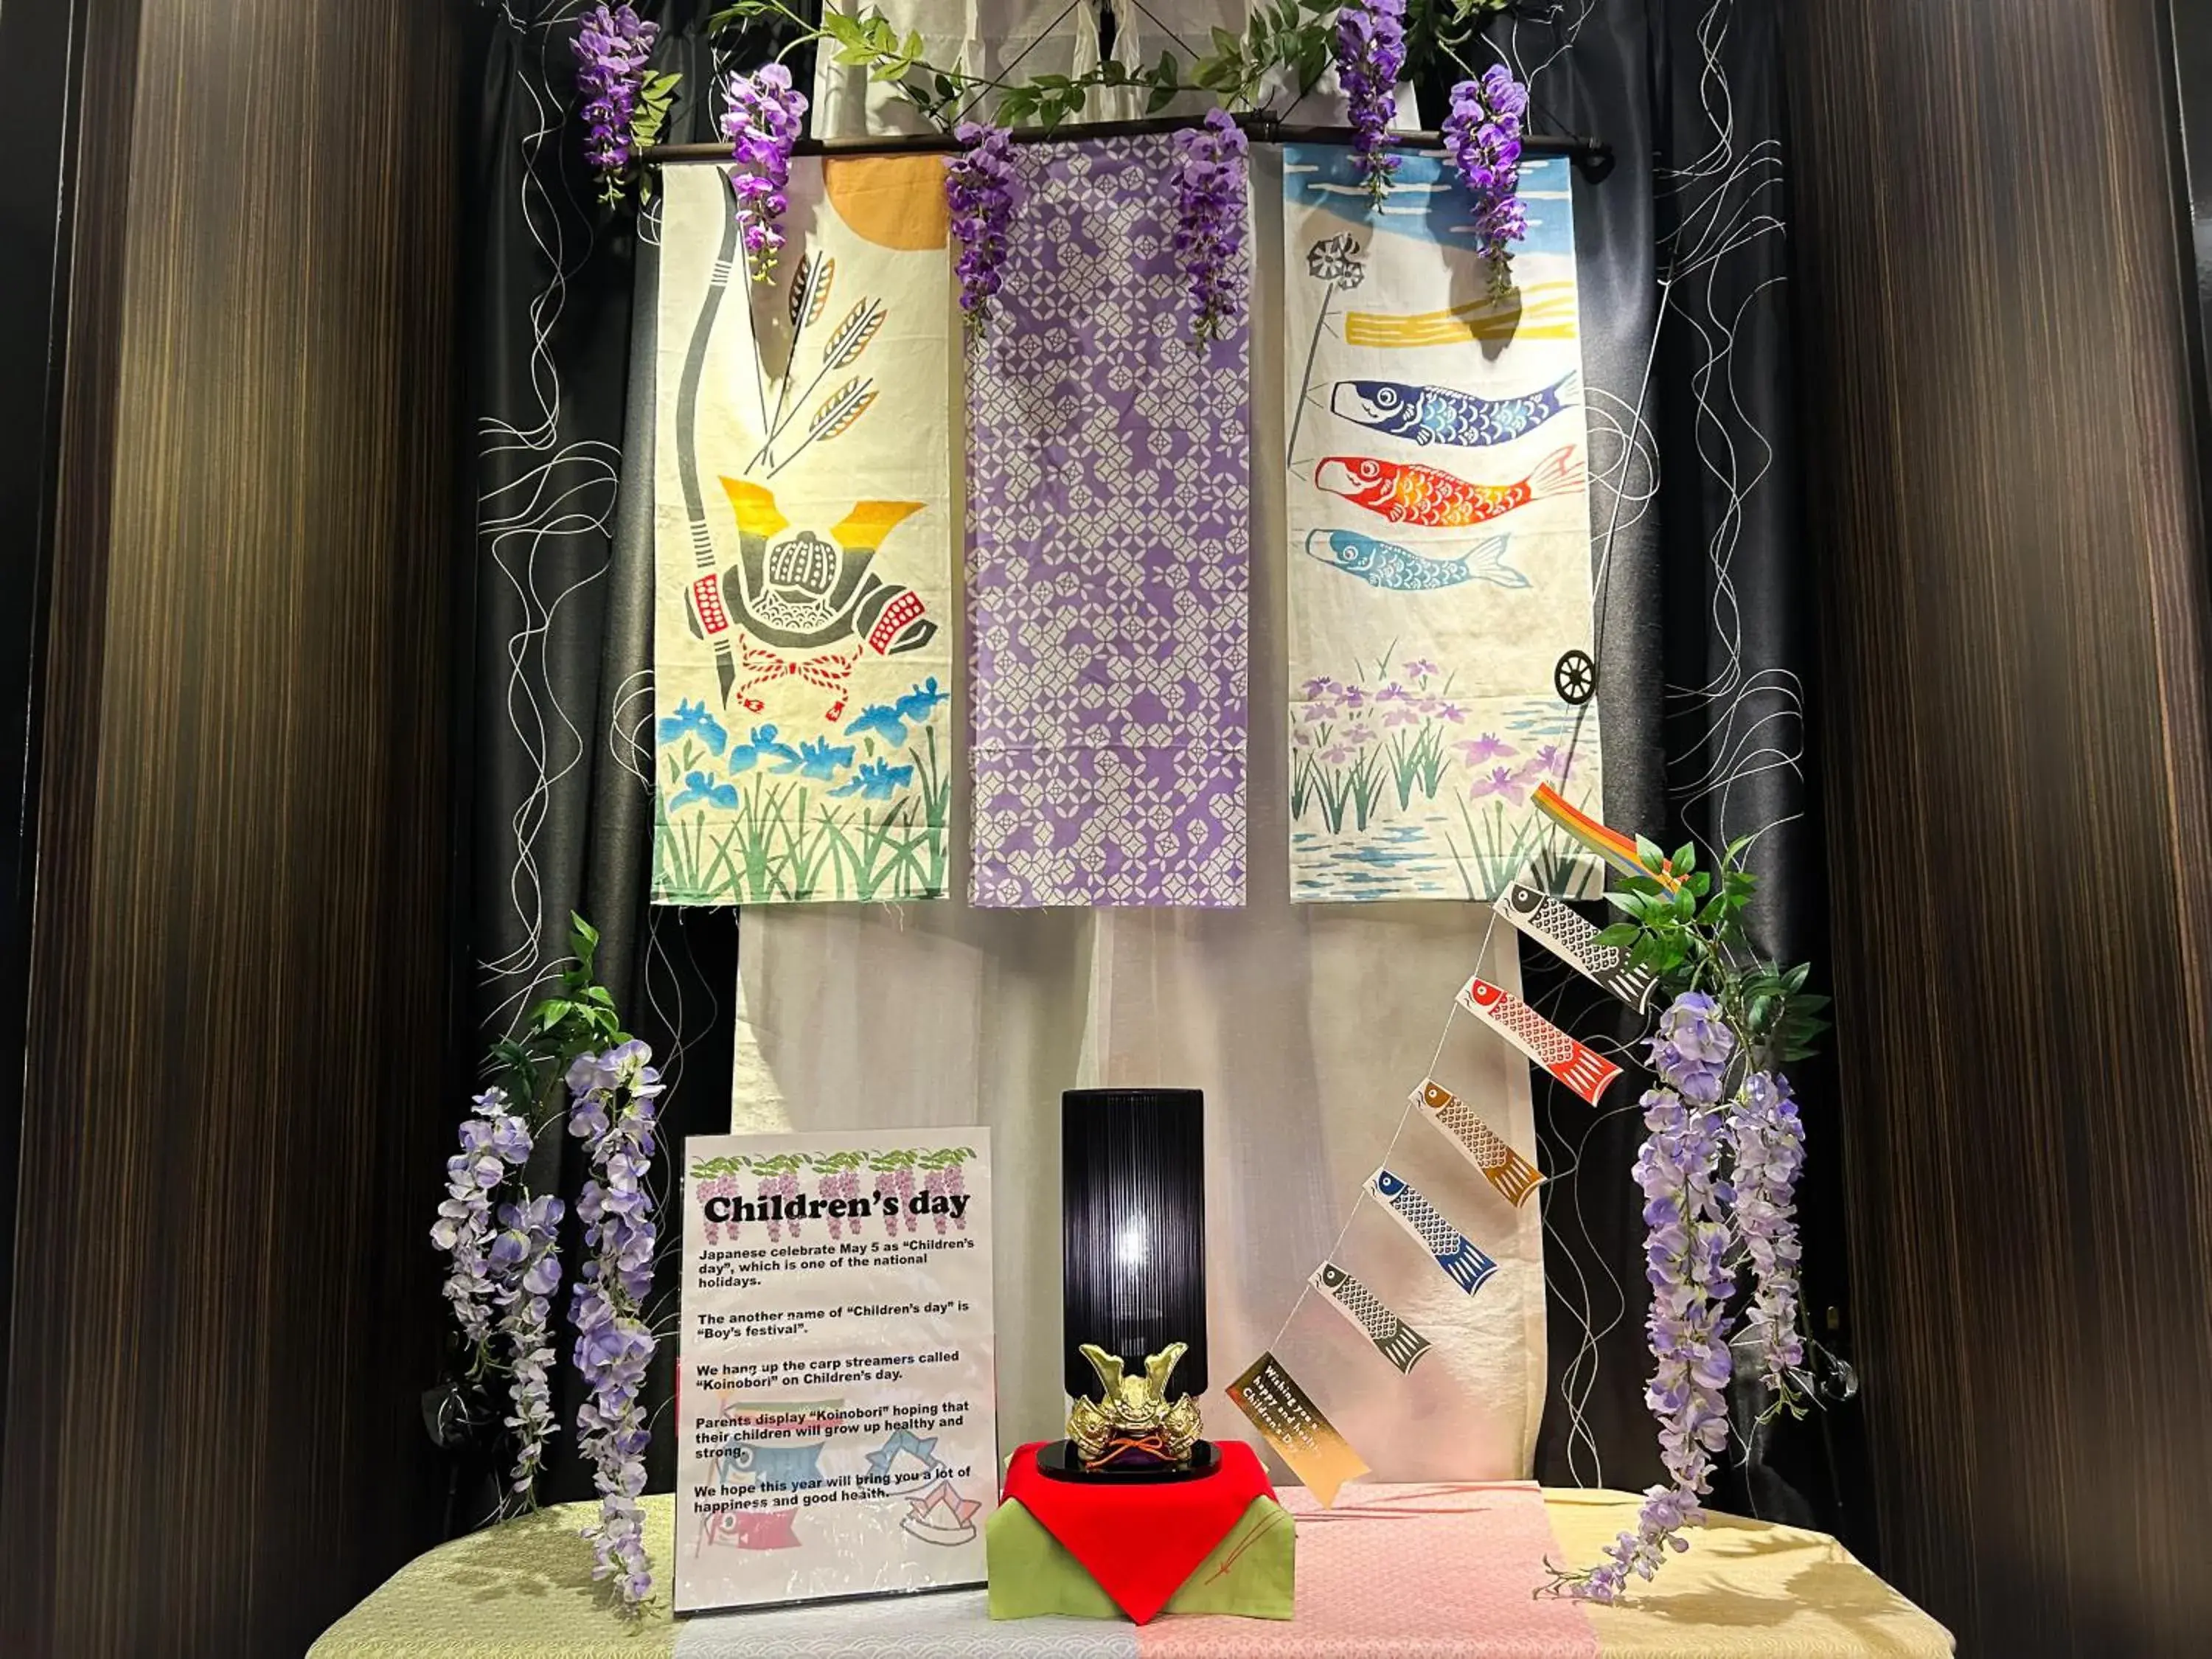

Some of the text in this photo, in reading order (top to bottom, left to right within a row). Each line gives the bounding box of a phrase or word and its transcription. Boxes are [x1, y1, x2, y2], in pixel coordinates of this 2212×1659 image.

[703, 1188, 971, 1223] Children’s day
[699, 1238, 975, 1262] Japanese celebrate May 5 as “Children’s
[698, 1253, 928, 1276] day”, which is one of the national
[698, 1276, 761, 1289] holidays.
[698, 1301, 970, 1325] The another name of “Children’s day” is
[697, 1323, 807, 1340] “Boy’s festival”.
[697, 1350, 959, 1377] We hang up the carp streamers called
[782, 1377, 799, 1385] on
[803, 1370, 872, 1384] Children’s
[875, 1369, 902, 1382] day.
[1253, 1375, 1278, 1406] happy
[1278, 1406, 1295, 1424] and
[1265, 1365, 1297, 1407] Wishing
[1293, 1405, 1312, 1422] you
[696, 1416, 751, 1430] Parents
[755, 1412, 806, 1427] display
[893, 1403, 938, 1418] hoping
[942, 1401, 969, 1413] that
[695, 1415, 964, 1444] their children will grow up healthy and
[695, 1447, 745, 1458] strong.
[694, 1466, 971, 1498] We hope this year will bring you a lot of
[694, 1499, 768, 1514] happiness
[773, 1494, 799, 1506] and
[802, 1491, 837, 1507] good
